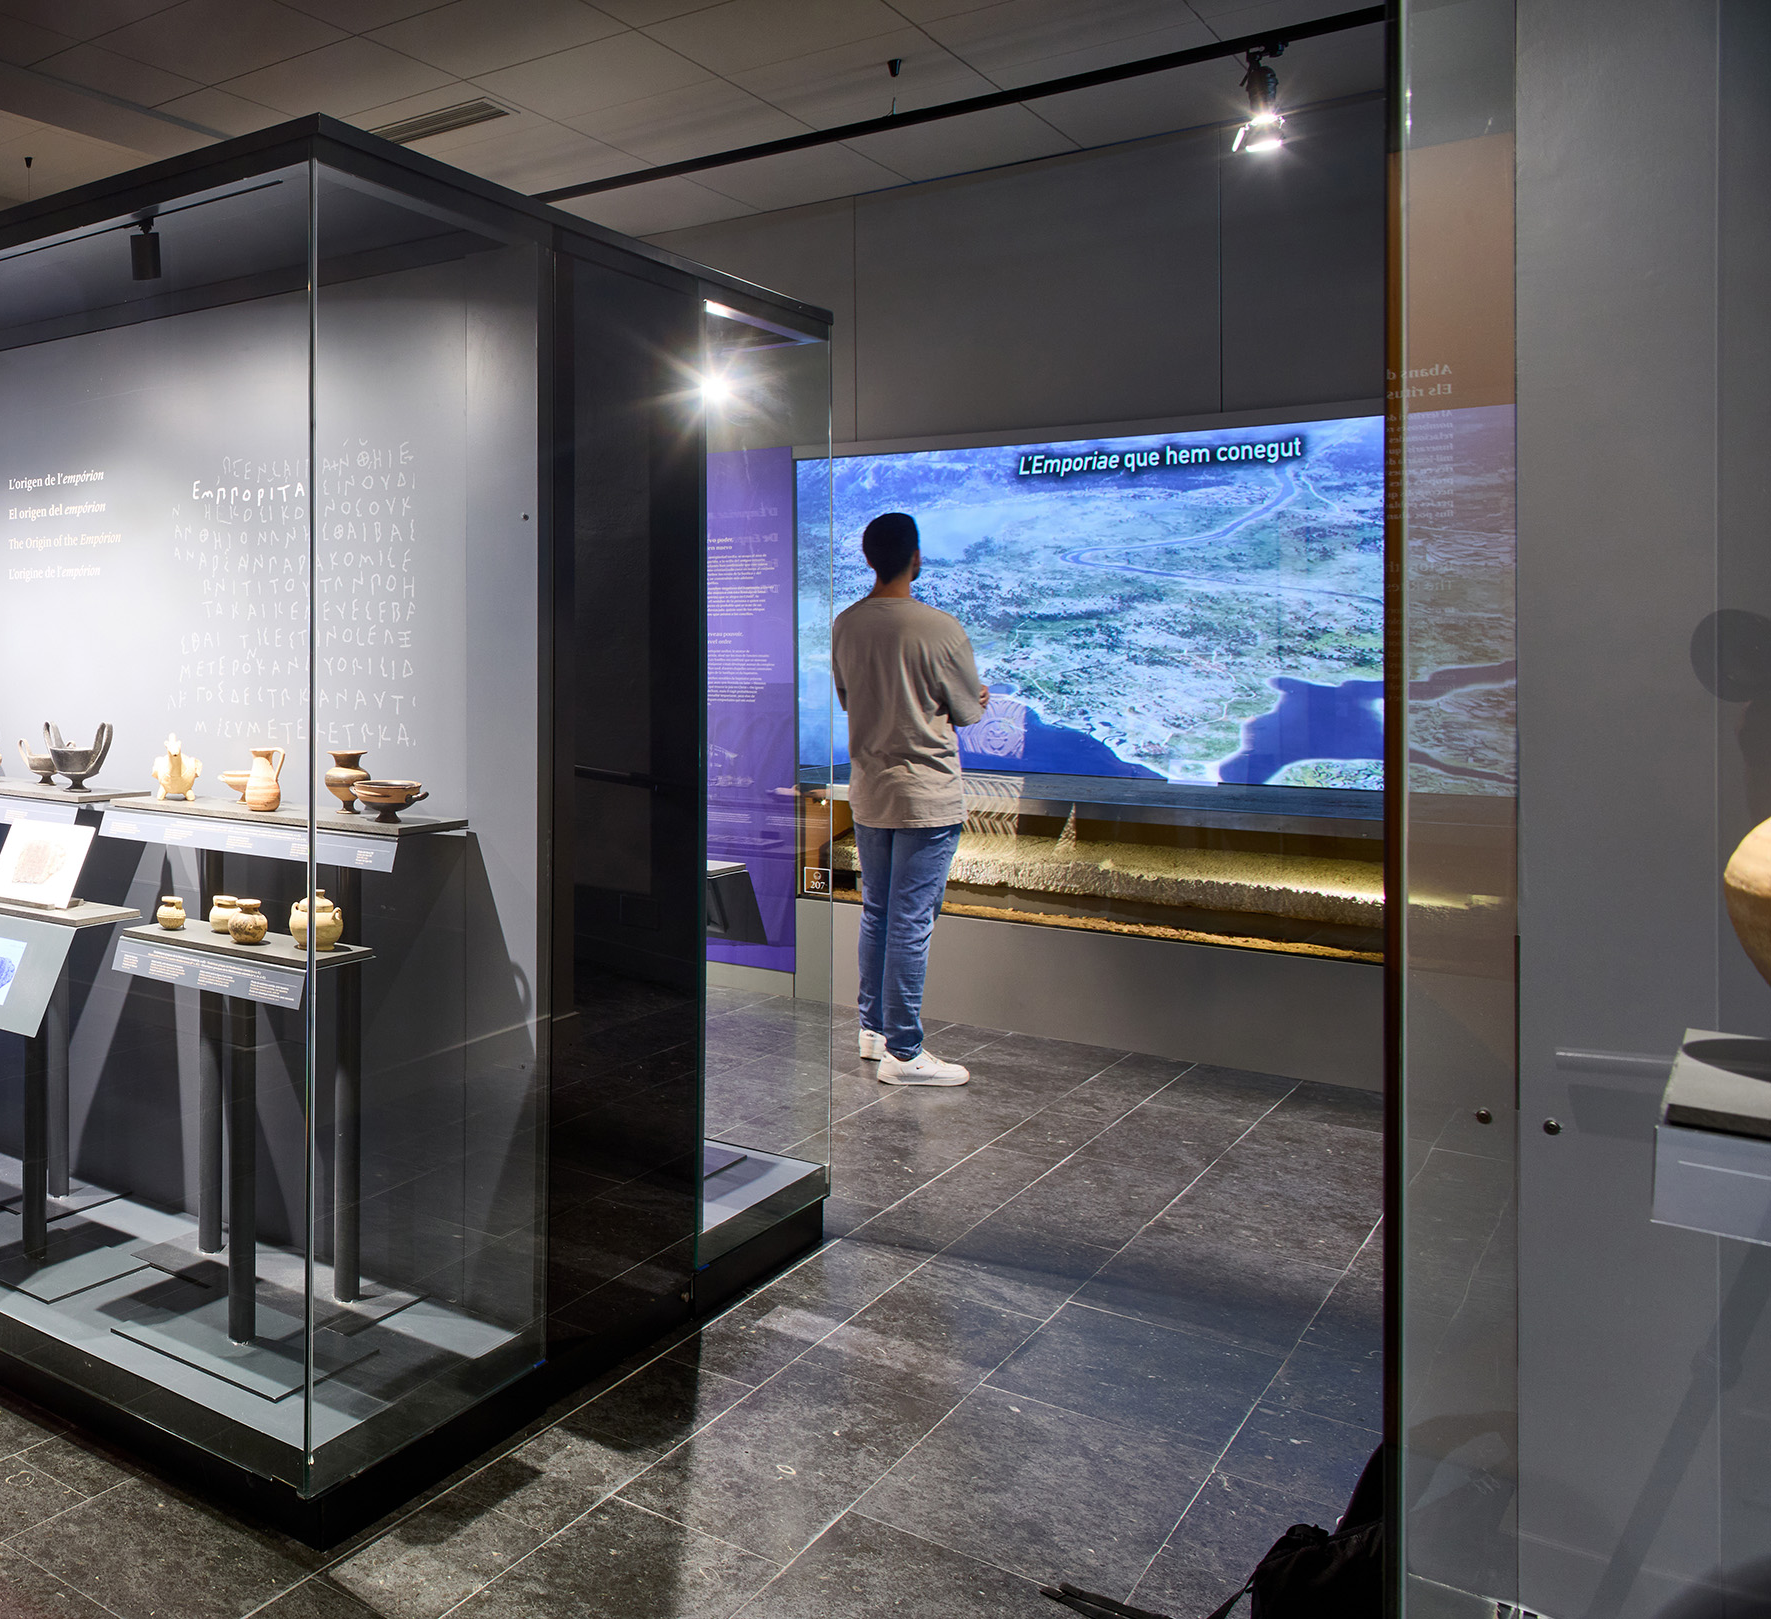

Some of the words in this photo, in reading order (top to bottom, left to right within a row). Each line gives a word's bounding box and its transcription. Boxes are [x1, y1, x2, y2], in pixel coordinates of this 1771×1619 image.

[1019, 450, 1120, 477] L'Emporiae
[1124, 450, 1160, 472] que
[1166, 445, 1210, 466] hem
[1216, 436, 1302, 463] conegut
[9, 477, 43, 491] L'origen
[45, 474, 56, 486] de
[57, 470, 104, 486] l'empórion
[9, 508, 17, 520] El
[19, 507, 47, 521] origen
[49, 504, 63, 516] del
[65, 501, 106, 517] empórion
[8, 538, 23, 550] The
[25, 536, 52, 551] Origin
[53, 534, 63, 547] of
[64, 534, 78, 546] the
[80, 531, 122, 547] Empórion
[9, 568, 43, 583] L'origine
[45, 566, 55, 578] de
[810, 881, 826, 889] 207
